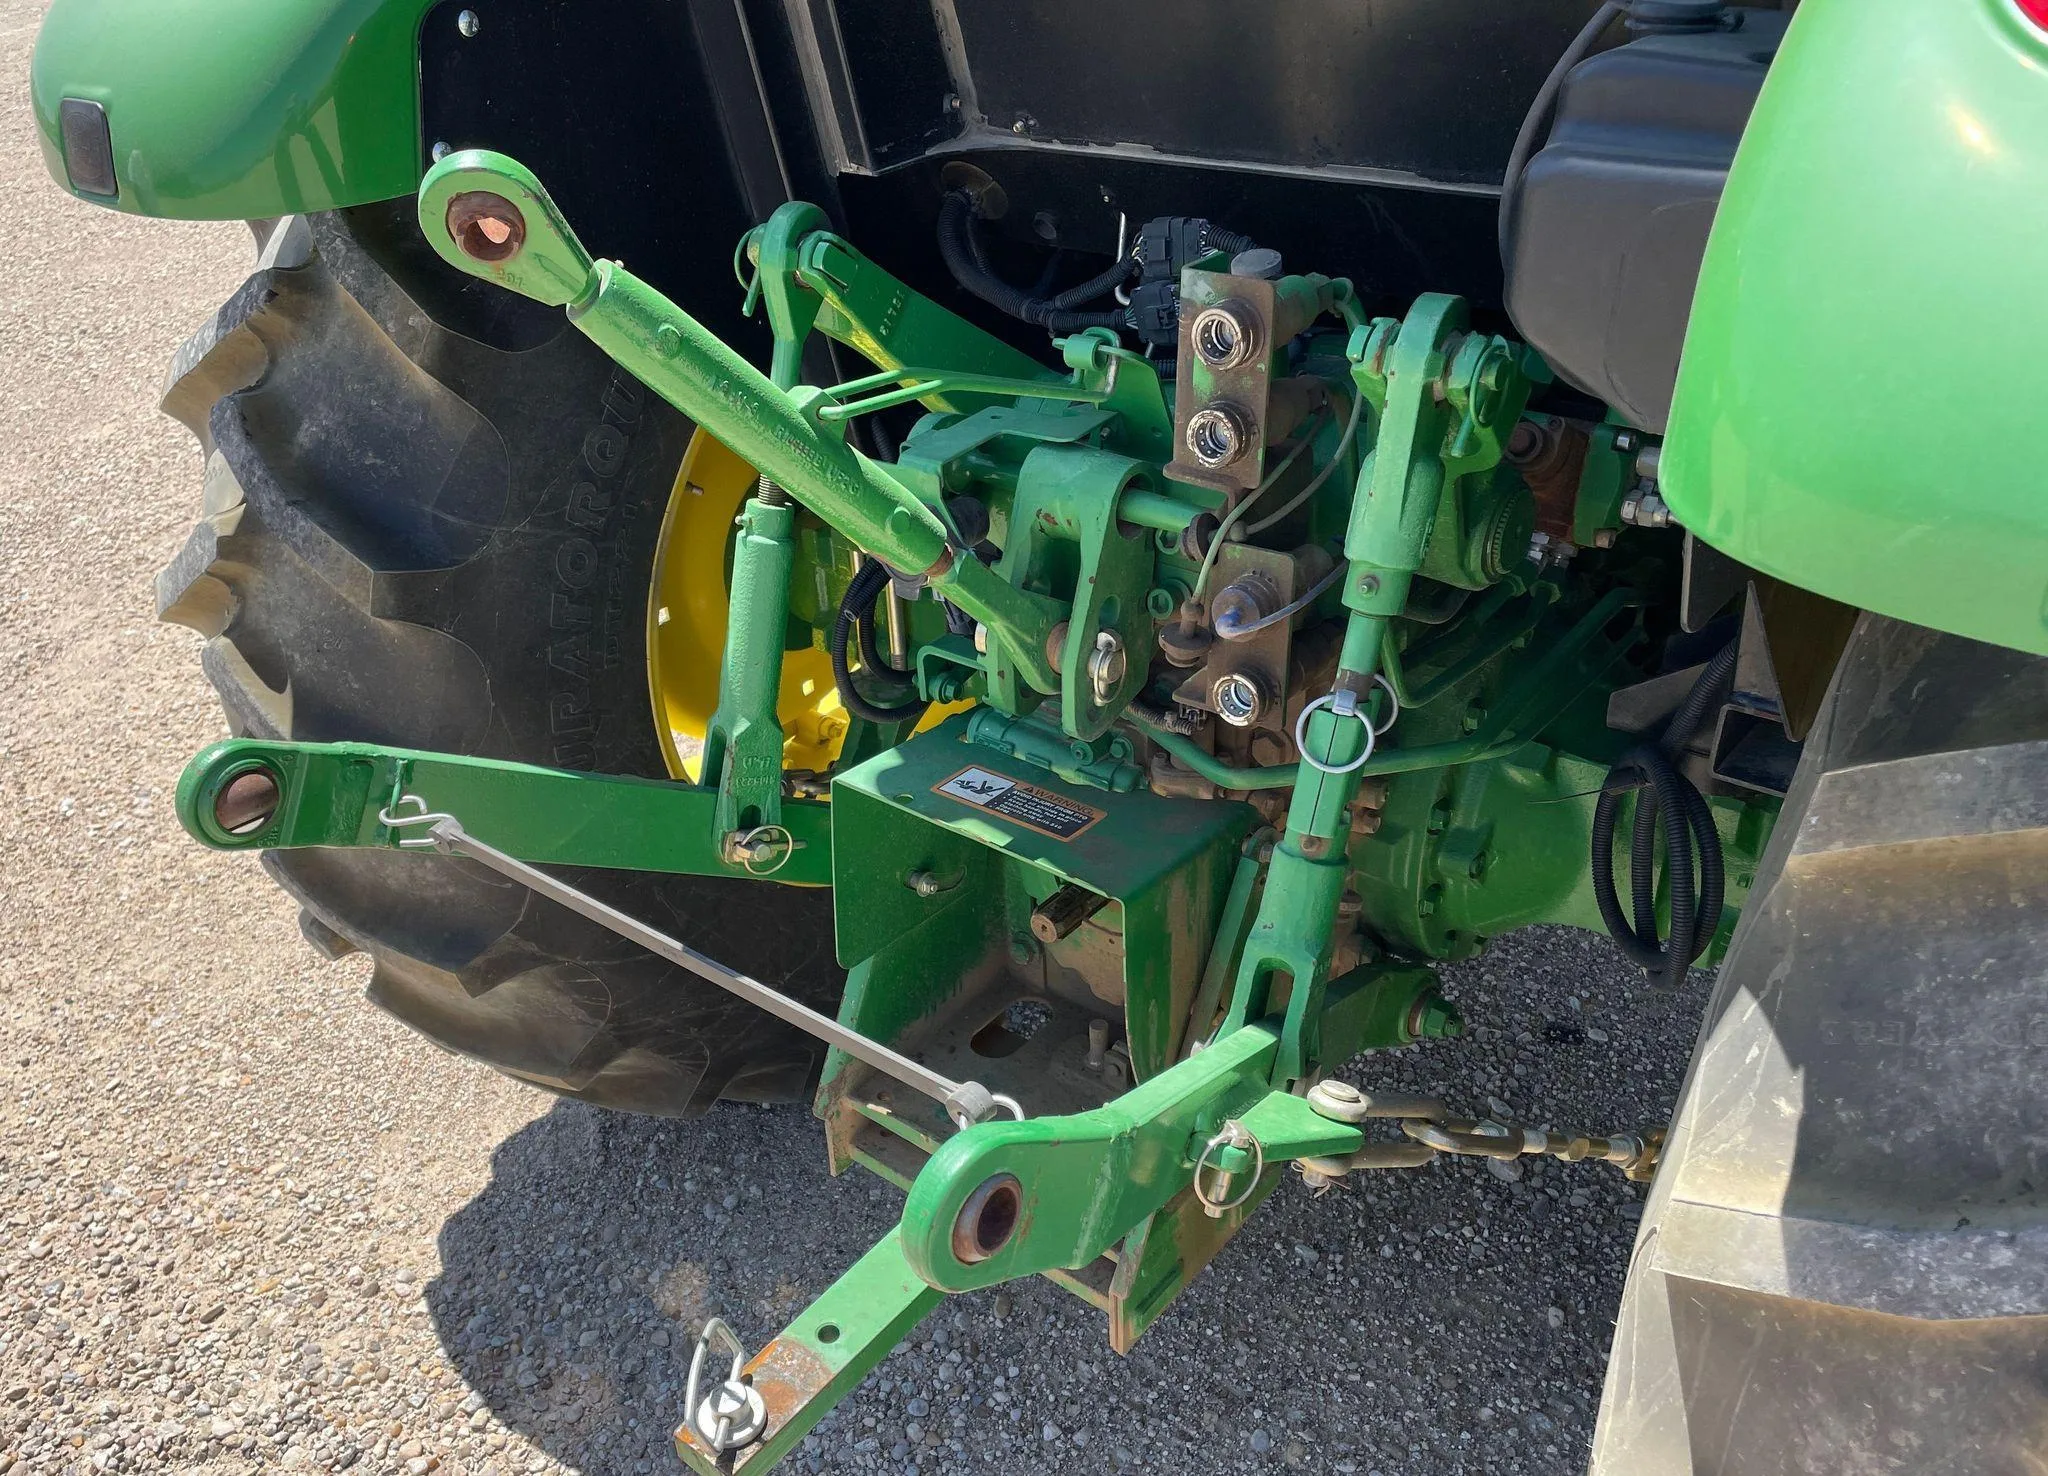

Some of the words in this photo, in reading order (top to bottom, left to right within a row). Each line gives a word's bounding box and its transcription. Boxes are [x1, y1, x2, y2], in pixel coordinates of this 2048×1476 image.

[1011, 790, 1033, 799] AVOID
[1030, 797, 1054, 807] INJURY
[1053, 805, 1074, 814] FROM
[1033, 790, 1093, 813] WARNING
[1064, 815, 1083, 823] place
